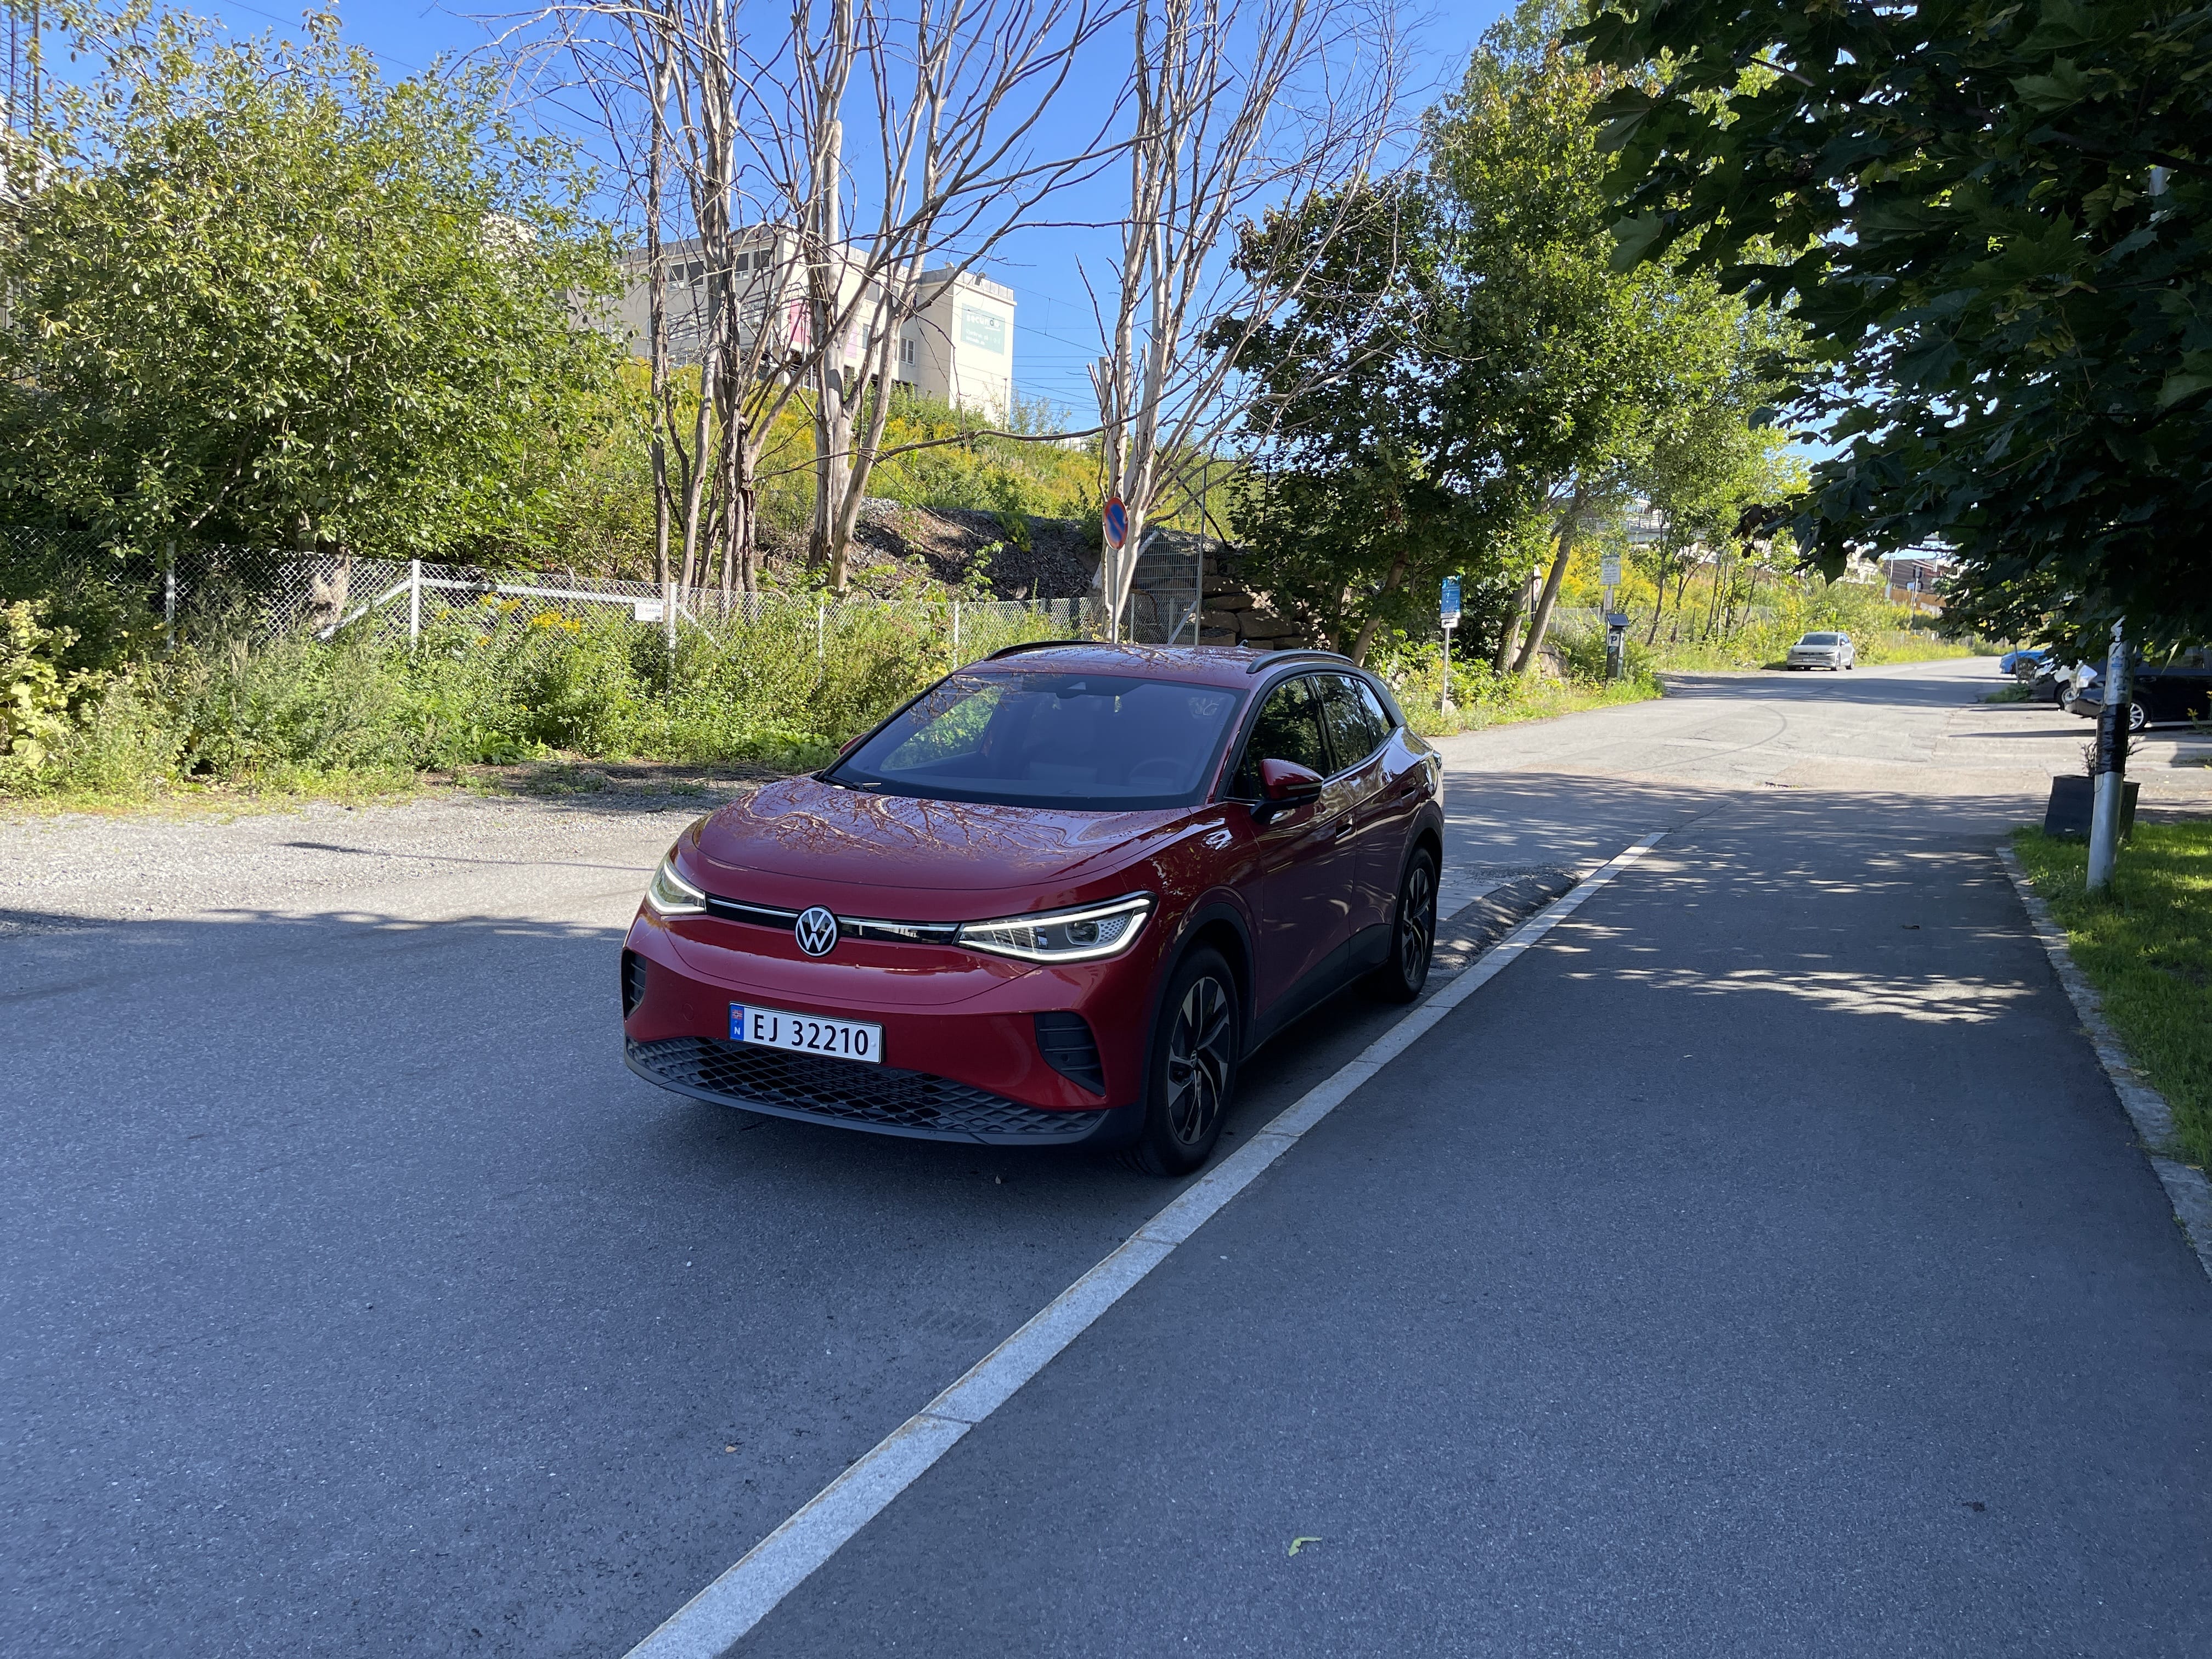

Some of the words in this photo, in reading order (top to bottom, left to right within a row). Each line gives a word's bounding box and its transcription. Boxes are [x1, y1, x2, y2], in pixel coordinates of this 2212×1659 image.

[1611, 636, 1617, 644] P
[734, 1026, 741, 1035] N
[754, 1014, 778, 1042] EJ
[791, 1020, 868, 1056] 32210
